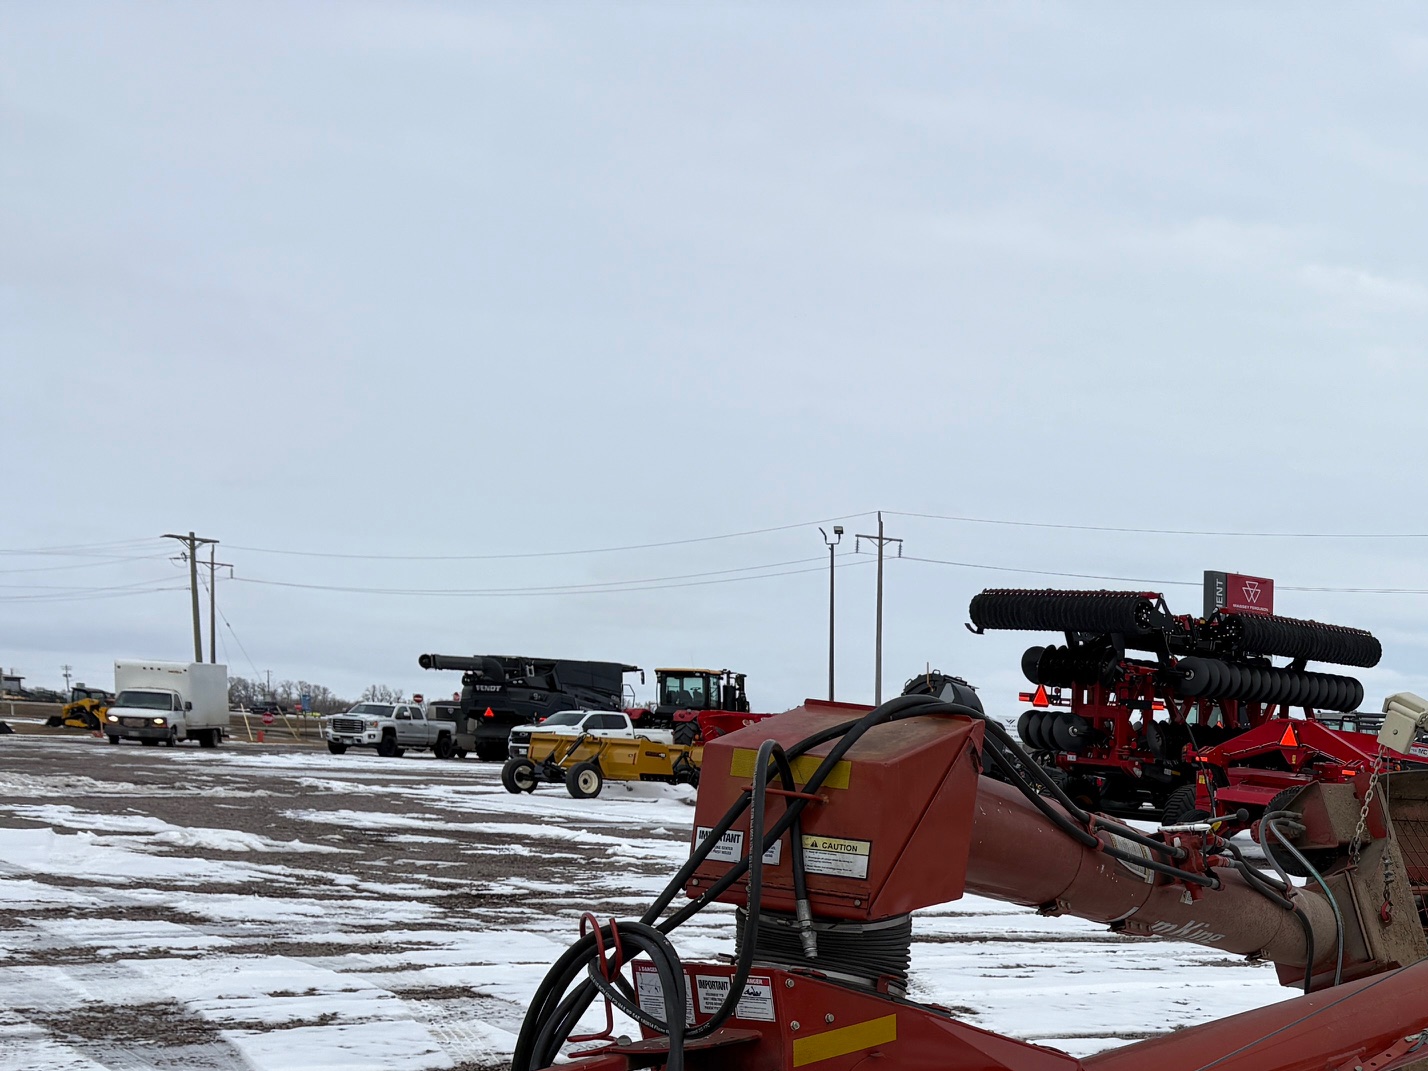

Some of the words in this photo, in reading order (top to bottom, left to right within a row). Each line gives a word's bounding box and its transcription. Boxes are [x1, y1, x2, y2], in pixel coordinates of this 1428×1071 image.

[1216, 578, 1224, 607] ENT
[698, 829, 741, 844] IMTANT
[821, 841, 858, 852] CAUTION
[698, 979, 729, 991] IMPORTANT
